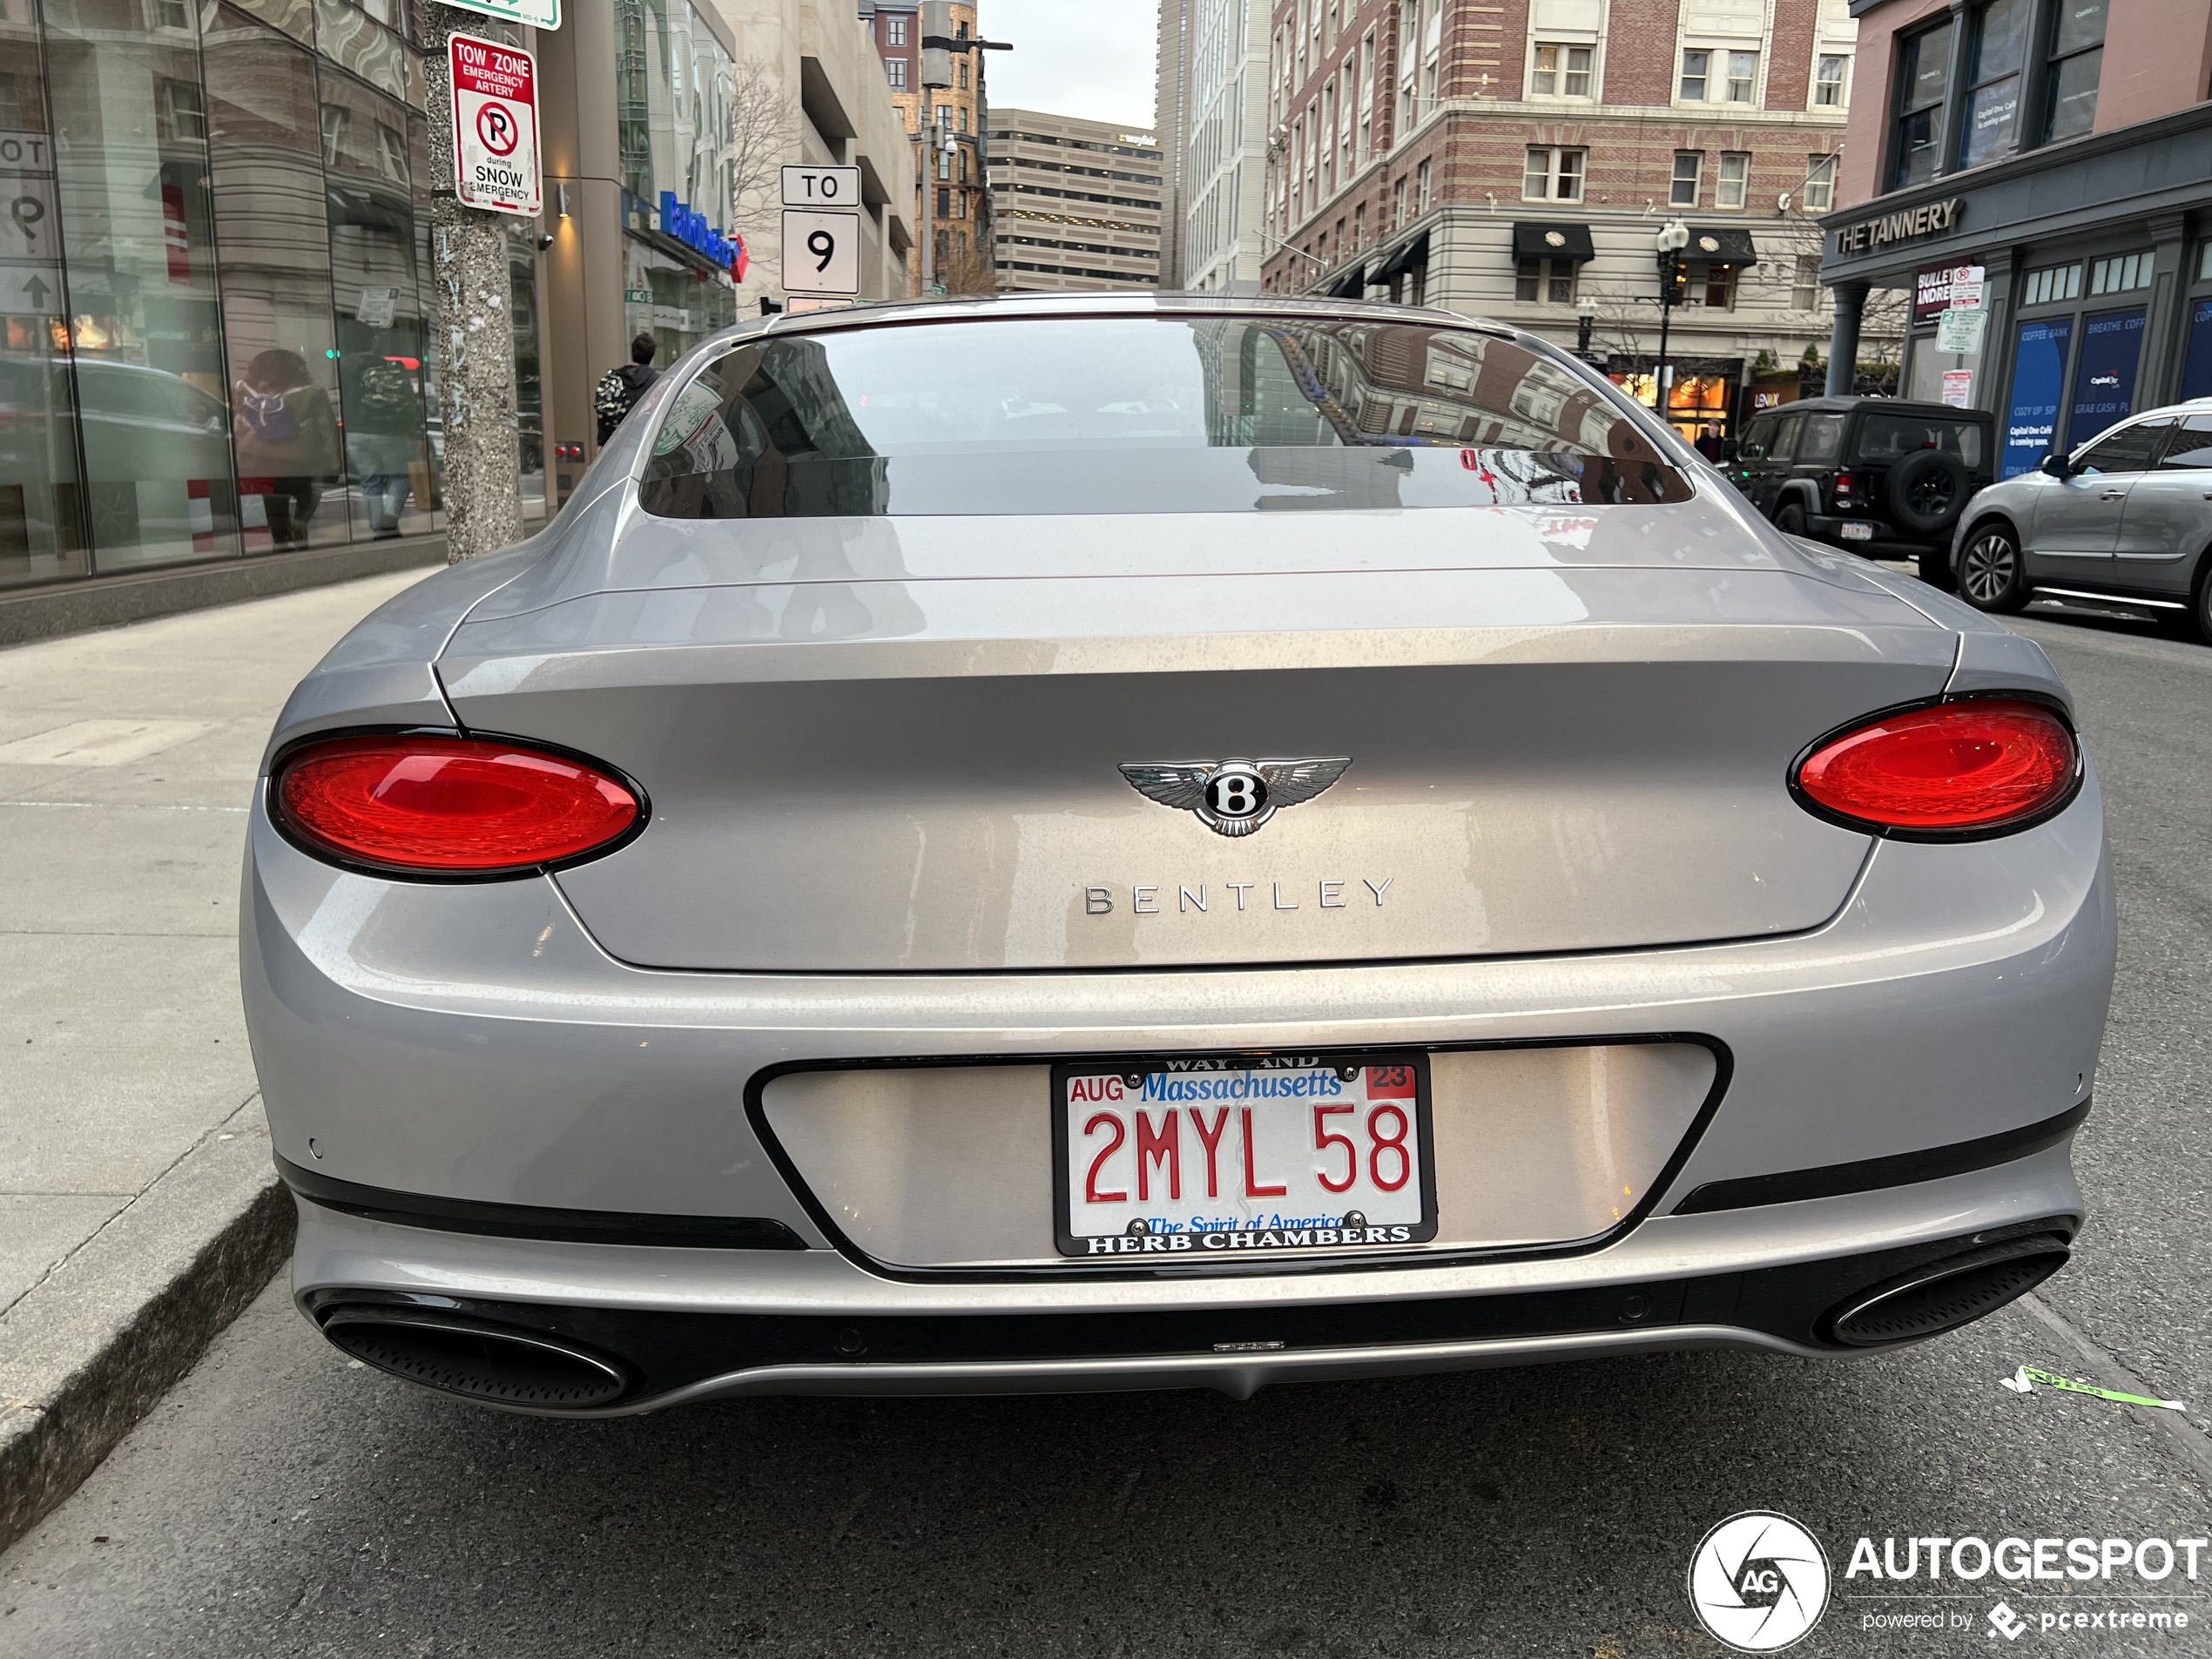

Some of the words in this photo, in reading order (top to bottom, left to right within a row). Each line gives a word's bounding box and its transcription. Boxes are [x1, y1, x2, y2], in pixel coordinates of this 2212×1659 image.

[455, 44, 486, 66] TOW
[492, 52, 530, 78] ZONE
[462, 65, 524, 89] EMERGENCY
[475, 80, 514, 98] ARTERY
[1125, 134, 1158, 147] wayfair
[487, 156, 512, 169] during
[475, 165, 523, 188] SNOW
[800, 175, 838, 199] TO
[470, 181, 529, 200] EMERGENCY
[1833, 223, 1866, 255] THE
[1867, 198, 1959, 246] TANNERY
[807, 230, 834, 273] 9
[2021, 329, 2047, 342] COFFEE
[2048, 327, 2069, 339] BANK
[2088, 320, 2122, 334] BREATHE
[2013, 406, 2032, 417] COZY
[2032, 405, 2043, 415] UP
[2045, 404, 2057, 415] SIP
[2075, 403, 2095, 415] GRAB
[2096, 402, 2116, 414] CASH
[2009, 426, 2028, 437] Capital
[2028, 425, 2040, 435] One
[2040, 424, 2054, 435] Café
[2009, 437, 2015, 447] is
[2015, 438, 2034, 448] coming
[2034, 437, 2049, 447] soon.
[1216, 778, 1257, 814] B
[1085, 878, 1394, 914] BENTLEY
[1166, 1056, 1319, 1072] WAYAND
[1141, 1069, 1342, 1103] Massachusetts
[1372, 1064, 1407, 1089] 23
[1070, 1077, 1124, 1103] AUG
[1083, 1105, 1287, 1204] 2MYL
[1313, 1103, 1412, 1194] 58
[1147, 1217, 1184, 1234] The
[1189, 1217, 1239, 1232] Spirit
[1244, 1215, 1264, 1231] of
[1087, 1233, 1192, 1255] HERB
[1202, 1226, 1412, 1251] CHAMBERS
